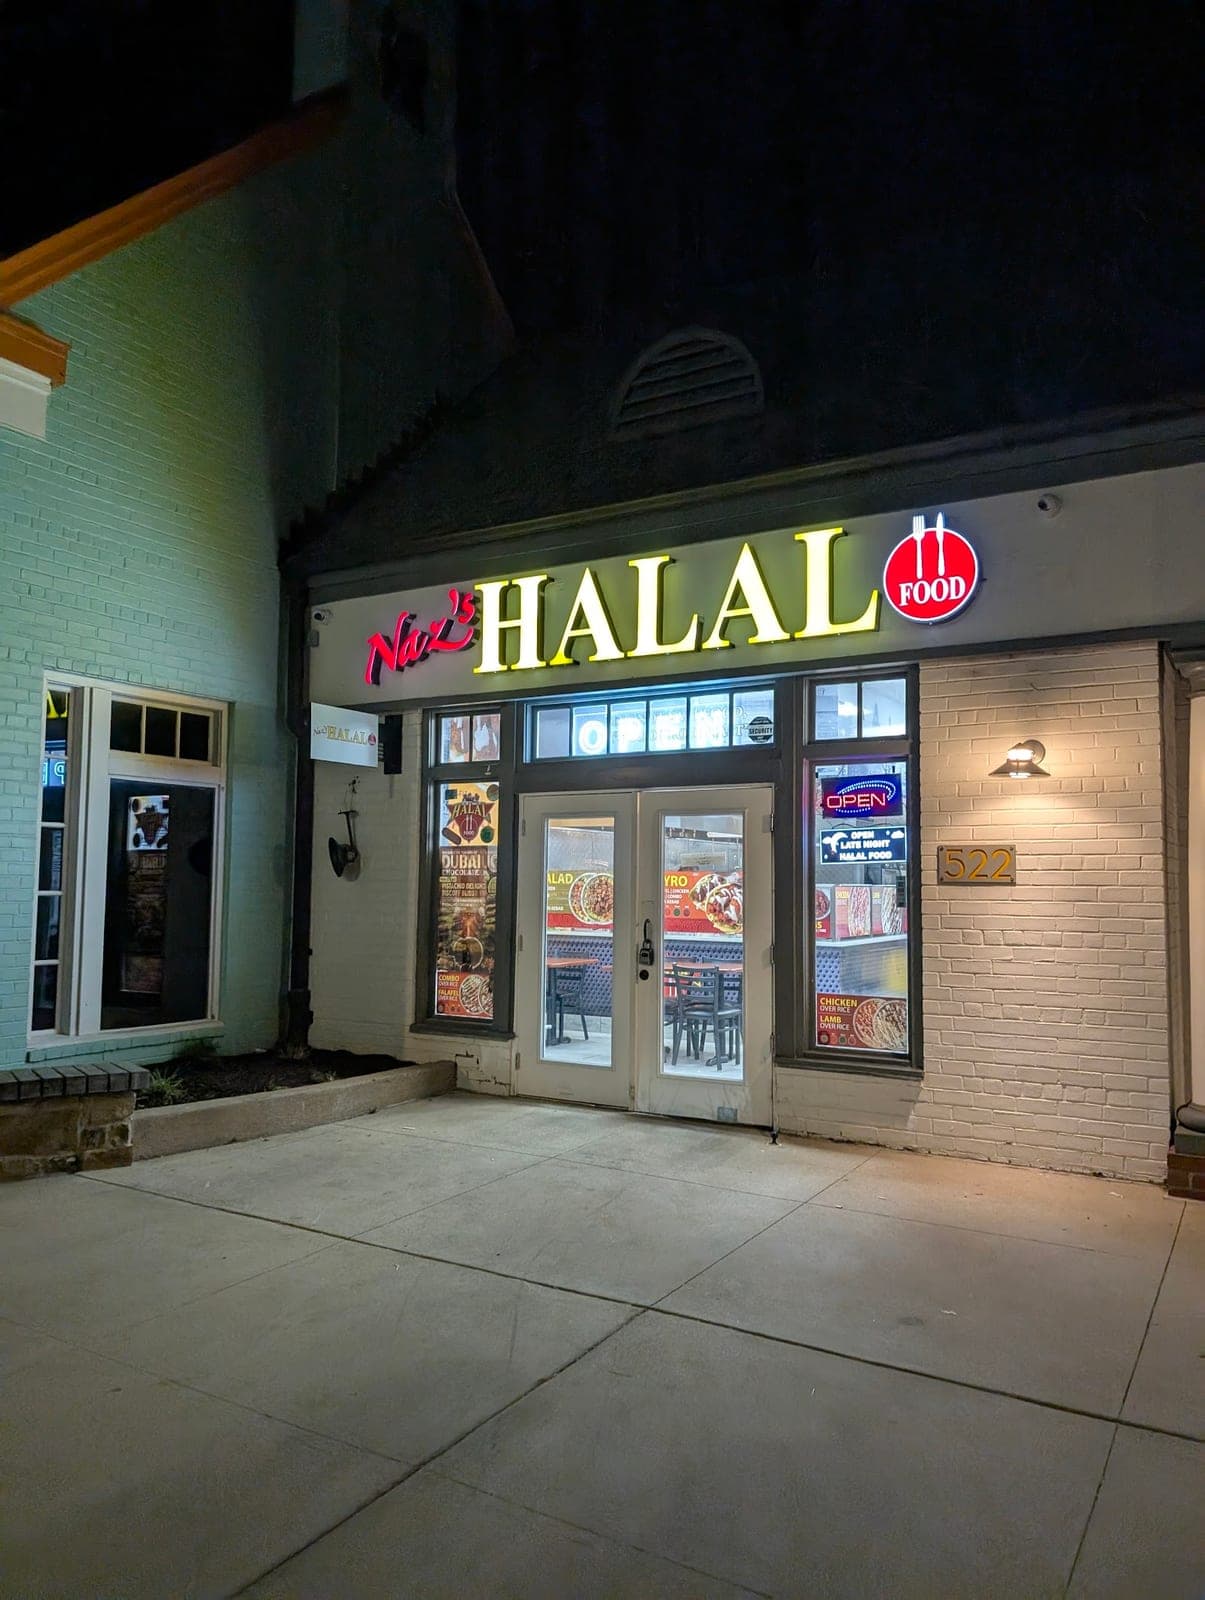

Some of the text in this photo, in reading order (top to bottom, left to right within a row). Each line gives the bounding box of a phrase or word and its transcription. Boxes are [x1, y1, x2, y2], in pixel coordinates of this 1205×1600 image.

[899, 576, 966, 606] FOOD
[364, 527, 878, 686] Naz's HALAL
[578, 709, 726, 754] OPEN
[748, 727, 773, 736] SECURITY
[827, 793, 886, 808] OPEN
[851, 831, 874, 839] OPEN
[841, 839, 890, 849] LATE NIGHT
[840, 851, 892, 860] HALAL FOOD
[442, 854, 481, 869] DUBAI
[944, 849, 1011, 880] 522
[664, 875, 688, 887] YRO
[820, 997, 858, 1007] CHICKEN
[837, 1006, 851, 1014] RICE
[820, 1015, 842, 1024] LAMB
